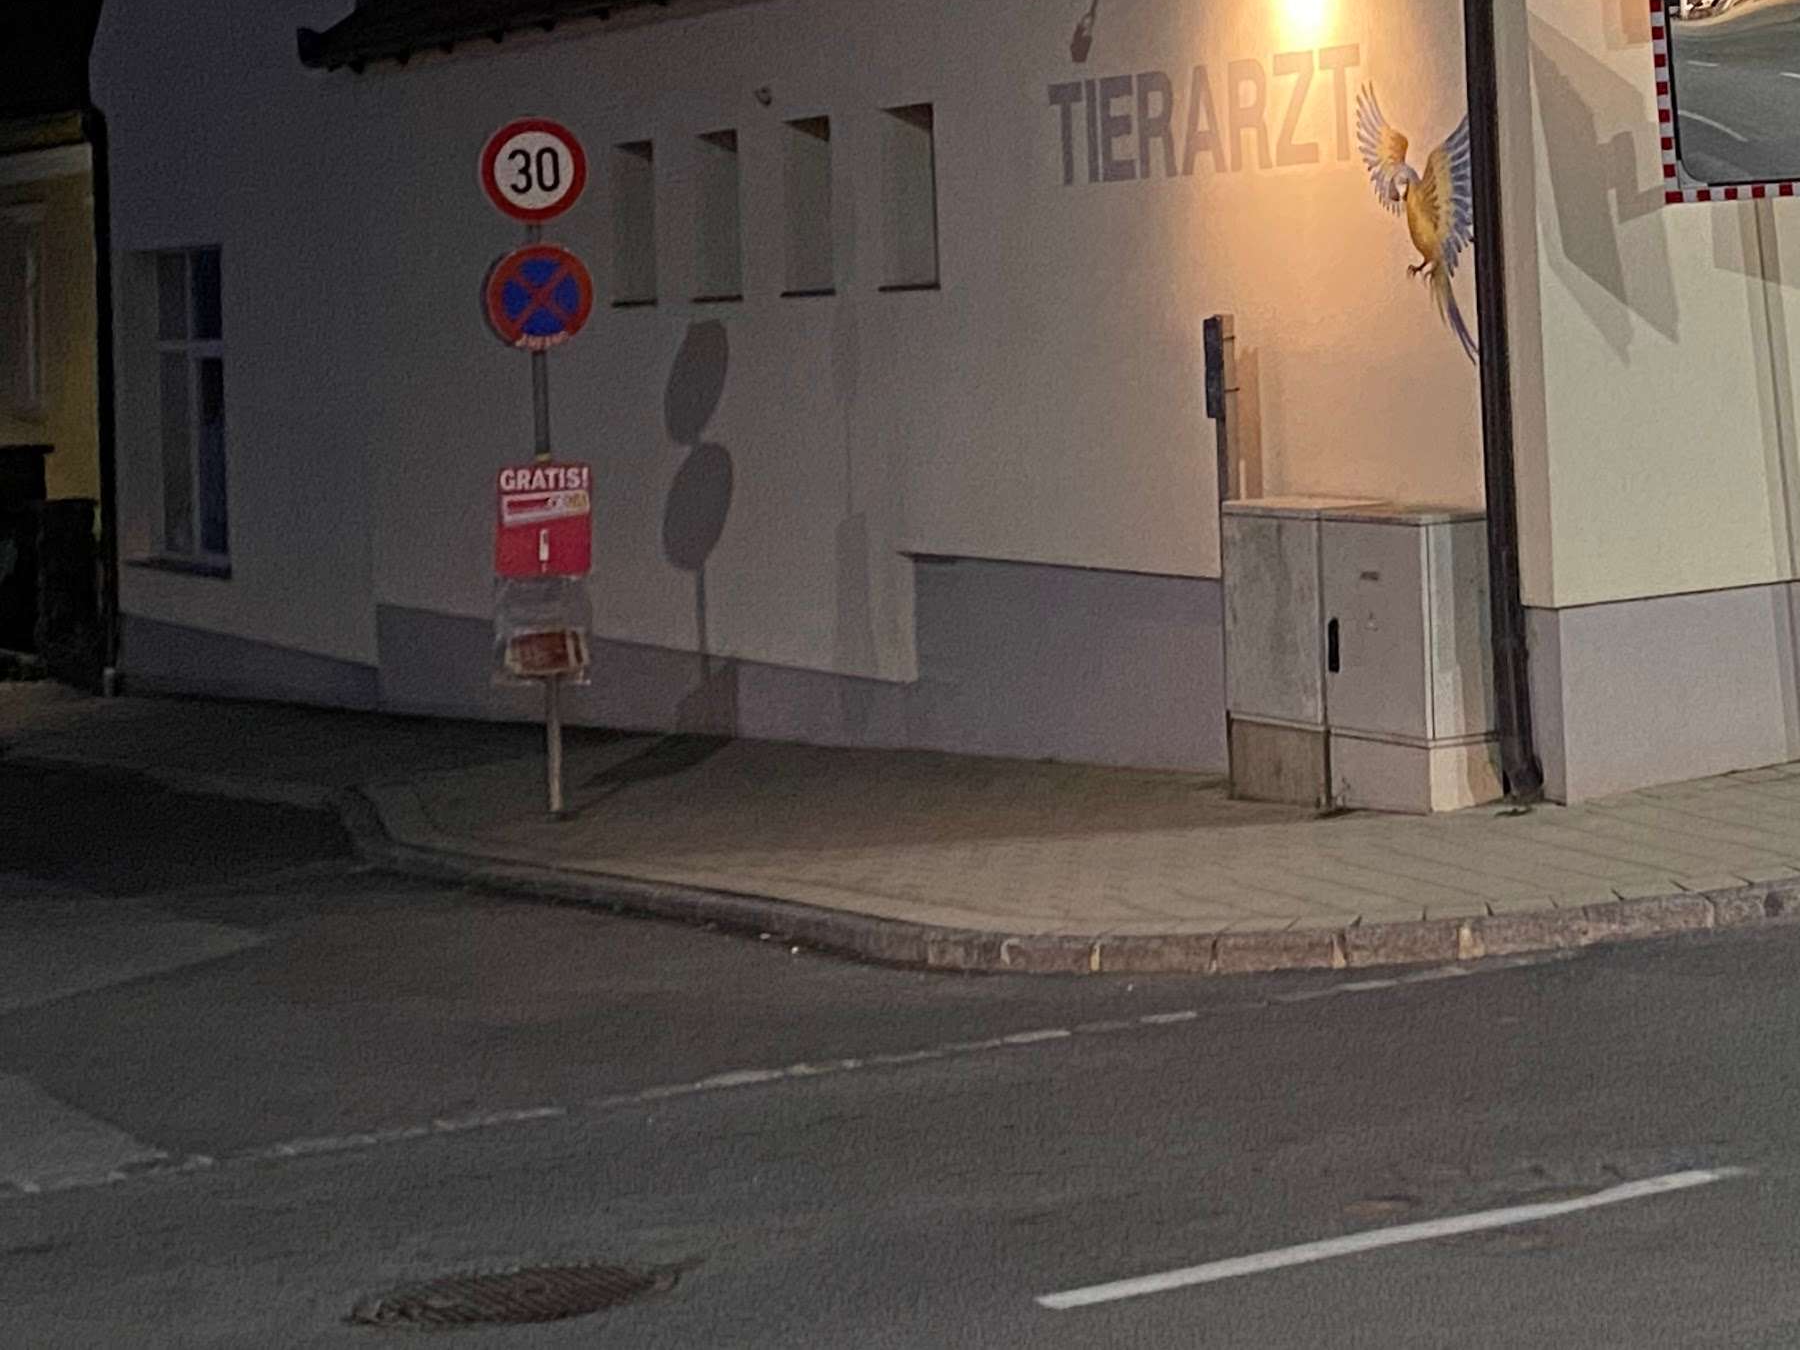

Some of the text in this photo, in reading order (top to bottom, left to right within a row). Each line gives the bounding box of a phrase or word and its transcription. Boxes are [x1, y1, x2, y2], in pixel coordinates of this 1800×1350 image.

[1047, 43, 1361, 186] TIERARZT
[507, 147, 561, 194] 30
[500, 467, 589, 491] GRATIS!
